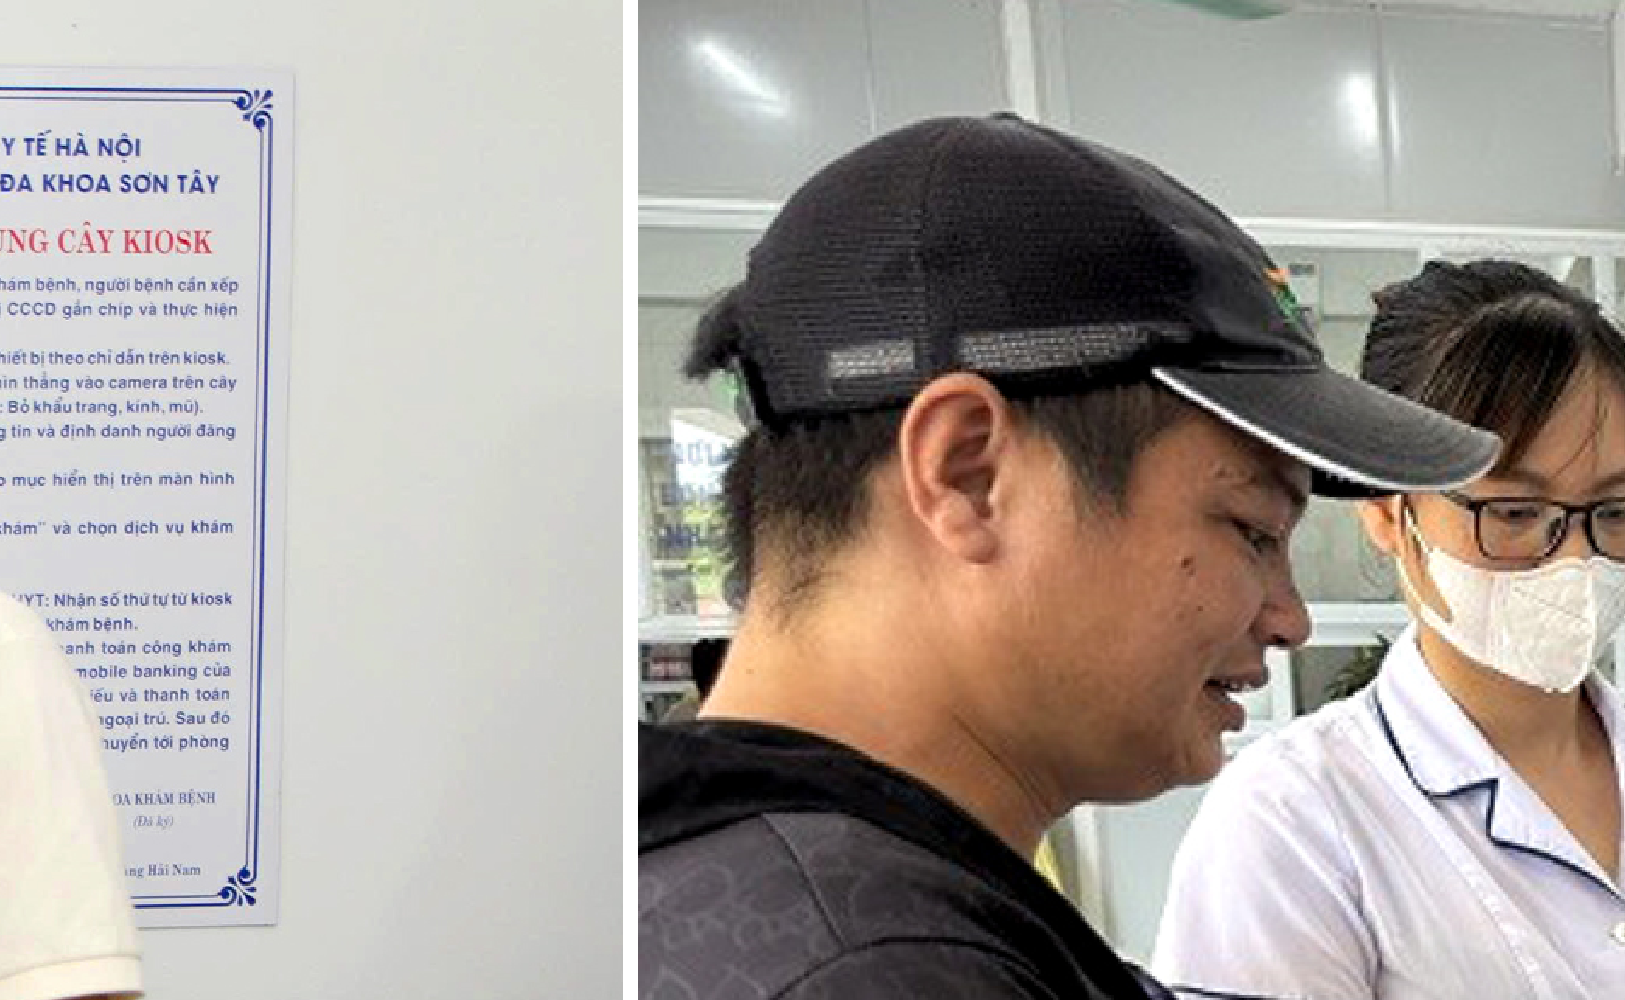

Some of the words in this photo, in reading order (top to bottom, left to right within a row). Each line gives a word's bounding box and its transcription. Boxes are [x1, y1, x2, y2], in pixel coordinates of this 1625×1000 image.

[1, 137, 16, 156] Y
[23, 129, 52, 157] TẾ
[54, 132, 89, 157] HÀ
[98, 132, 142, 164] NỘI
[42, 173, 112, 193] KHOA
[120, 171, 170, 195] SƠN
[176, 169, 221, 195] TÂY
[57, 221, 115, 254] CÂY
[123, 229, 213, 255] KIOSK
[34, 277, 81, 294] bệnh,
[84, 277, 131, 296] người
[134, 277, 174, 293] bệnh
[177, 275, 207, 293] cần
[210, 275, 240, 296] xếp
[6, 302, 56, 316] CCCD
[62, 298, 92, 321] gắn
[98, 302, 134, 319] chip
[138, 302, 157, 316] và
[162, 302, 198, 318] thực
[204, 302, 238, 319] hiện
[29, 350, 45, 366] bị
[48, 351, 84, 366] theo
[87, 348, 112, 366] chỉ
[115, 348, 145, 366] dẫn
[148, 350, 181, 366] trên
[183, 350, 230, 366] kiosk.
[51, 521, 72, 535] và
[78, 521, 118, 538] chọn
[123, 519, 159, 537] dịch
[165, 522, 185, 535] vụ
[191, 519, 233, 534] khám
[132, 664, 198, 681] banking
[202, 661, 232, 678] của
[143, 710, 170, 726] trú.
[174, 710, 206, 726] Sau
[210, 710, 232, 725] đó
[134, 793, 174, 806] KHÁM
[177, 788, 216, 807] BỆNH
